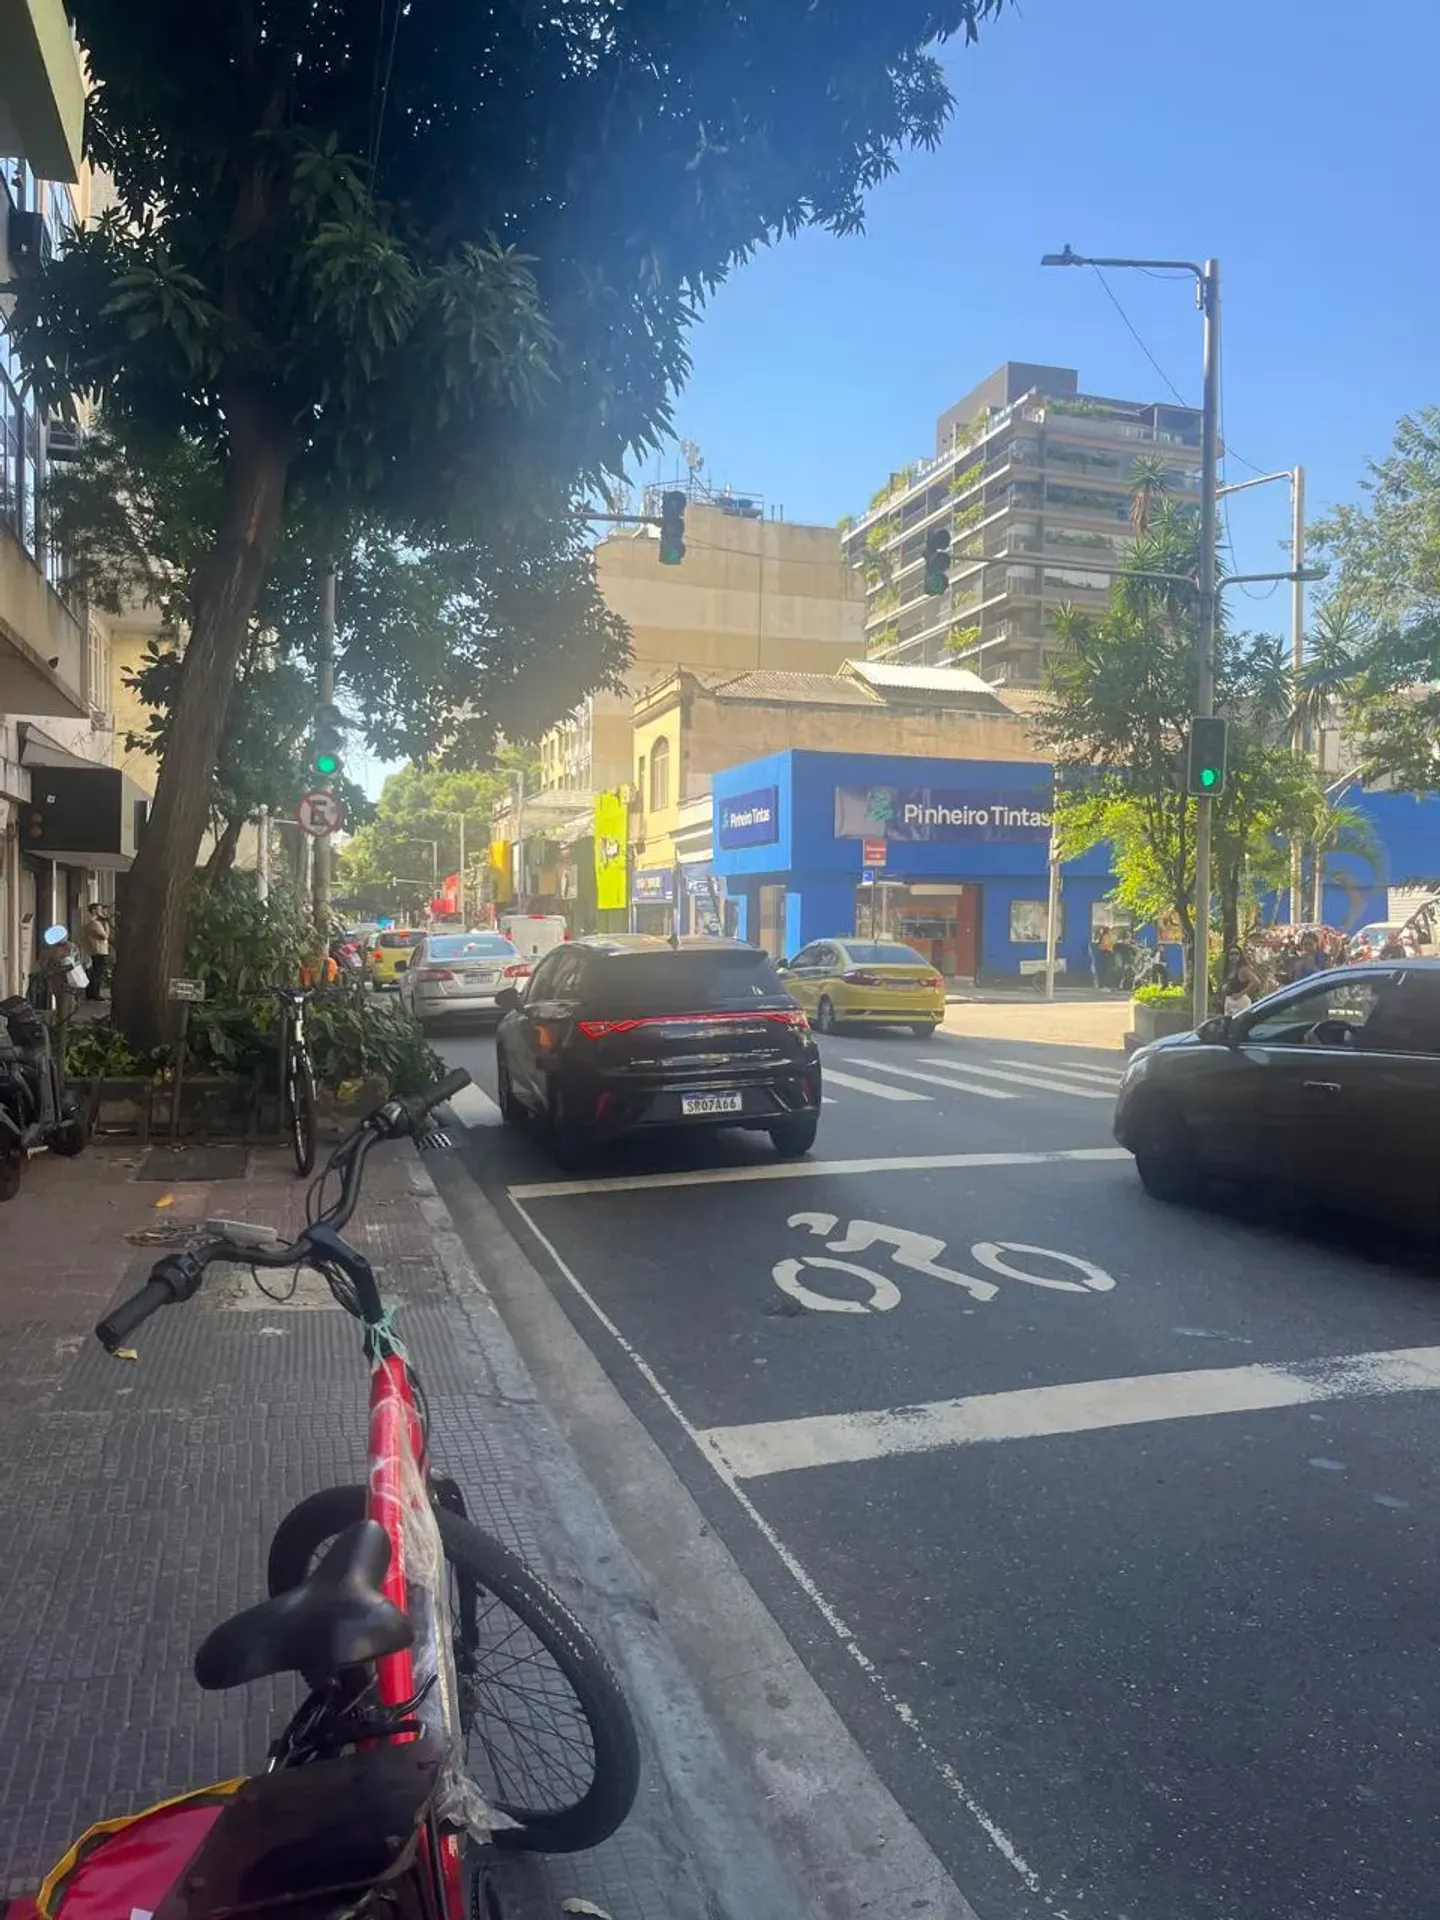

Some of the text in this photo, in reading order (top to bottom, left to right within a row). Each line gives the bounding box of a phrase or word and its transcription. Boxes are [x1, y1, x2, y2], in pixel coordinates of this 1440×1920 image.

[730, 807, 770, 828] Pinheiro Tintas
[904, 804, 1051, 827] Pinheiro Tintas
